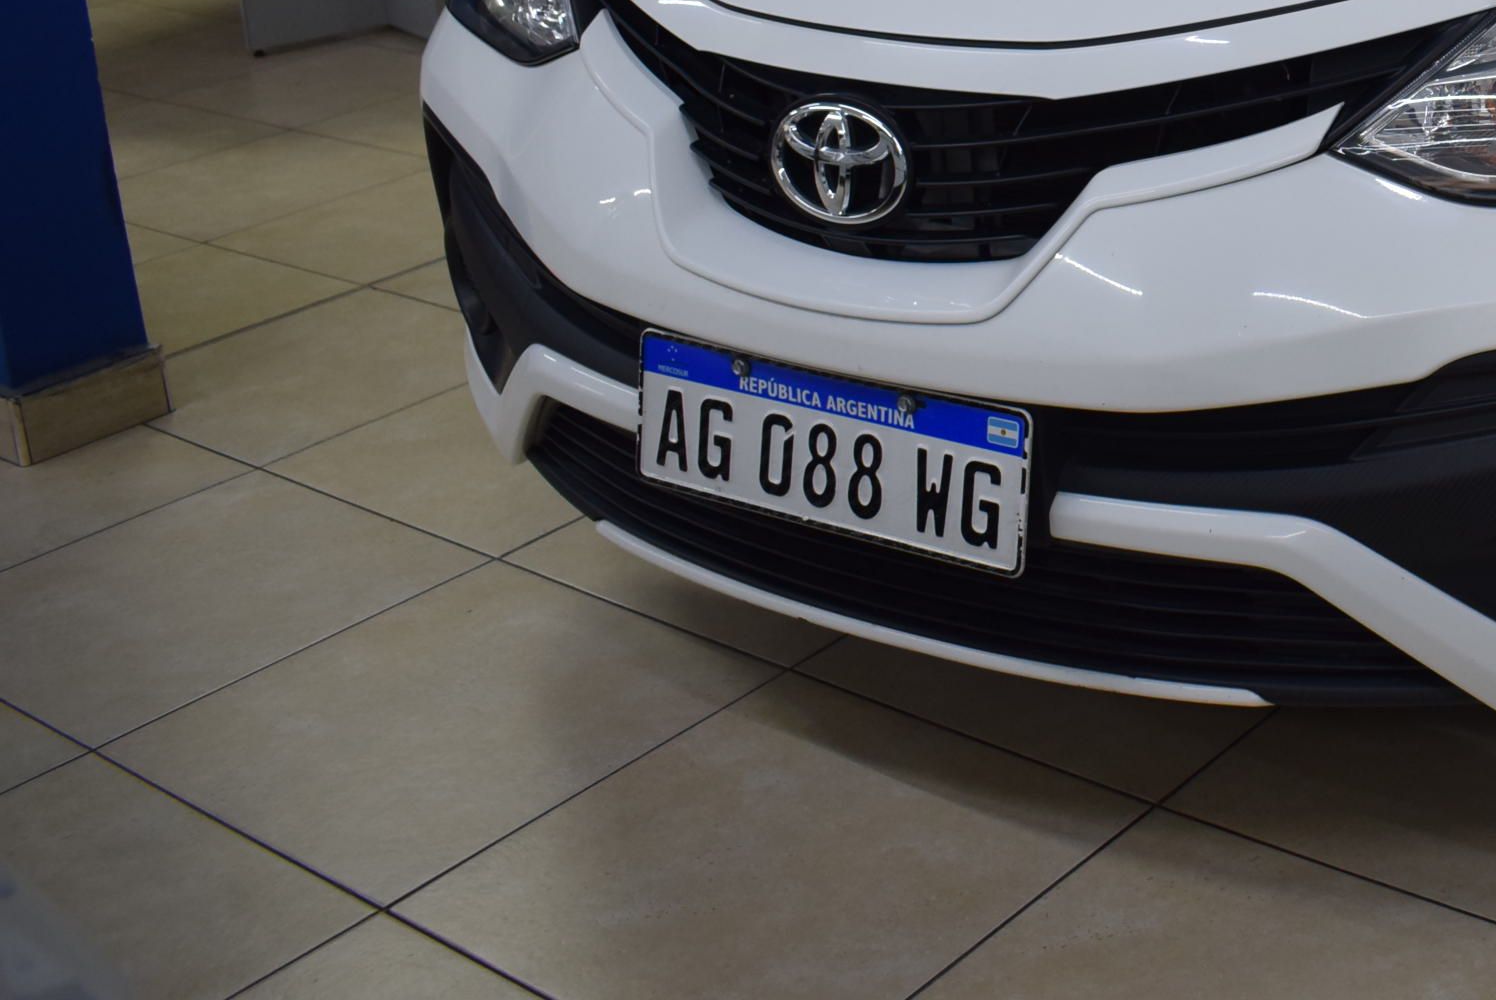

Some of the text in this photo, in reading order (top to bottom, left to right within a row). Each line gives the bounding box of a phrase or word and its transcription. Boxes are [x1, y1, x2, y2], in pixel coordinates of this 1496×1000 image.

[657, 364, 689, 377] MERCOSUR
[739, 376, 915, 430] REPÚBLICA ARGENTINA
[656, 390, 1002, 549] AG 088 WG
